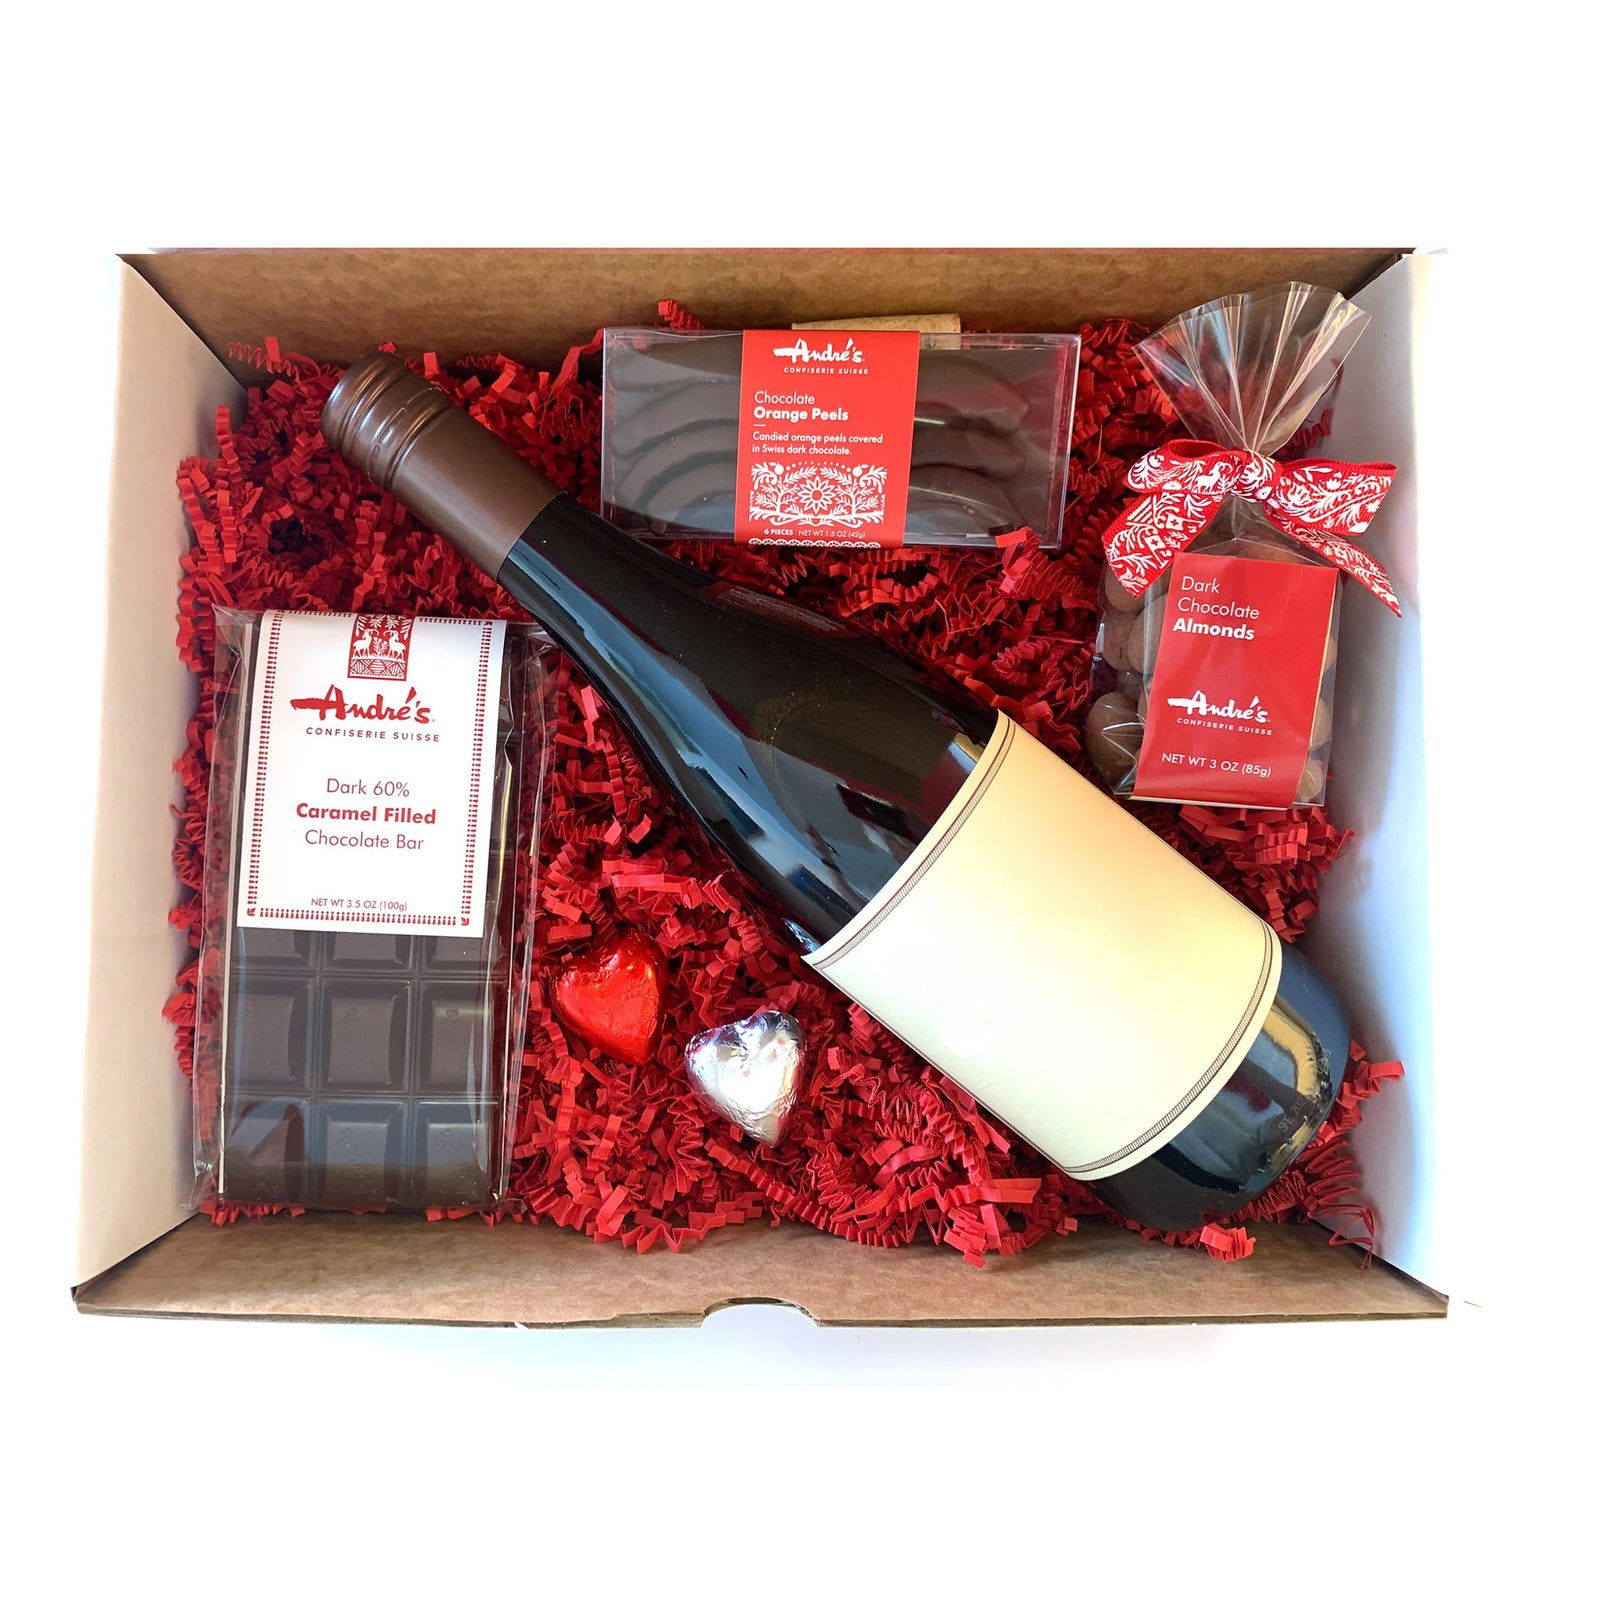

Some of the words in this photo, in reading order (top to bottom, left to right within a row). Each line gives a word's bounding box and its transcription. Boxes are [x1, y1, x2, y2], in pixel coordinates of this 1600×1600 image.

[773, 338, 864, 363] André's
[754, 391, 815, 404] Chocolate
[754, 406, 808, 423] Orange
[812, 408, 848, 420] Peels
[752, 431, 789, 442] Candied
[791, 434, 821, 444] orange
[824, 433, 846, 444] peels
[848, 434, 883, 443] covered
[752, 444, 760, 453] in
[762, 444, 784, 454] Swiss
[786, 444, 806, 454] dark
[808, 445, 852, 456] chocolate.
[848, 531, 866, 540] (42g)
[1181, 576, 1220, 594] Dark
[1178, 596, 1260, 620] Chocolate
[1172, 618, 1255, 640] Almonds
[290, 684, 432, 724] André's
[1167, 690, 1268, 724] André's
[306, 727, 386, 740] CONFISERIE
[393, 732, 440, 742] SUISSE
[1176, 718, 1234, 731] CONFISERIE
[1238, 726, 1272, 736] SUISSE
[1161, 752, 1184, 764] NET
[1188, 756, 1206, 768] WT
[1210, 758, 1216, 770] 3
[1220, 760, 1238, 772] OZ
[1242, 762, 1272, 778] (85g)
[326, 778, 366, 795] Dark
[373, 780, 410, 798] 60%
[296, 802, 376, 822] Caramel
[384, 808, 436, 824] Filled
[304, 829, 389, 849] Chocolate
[396, 834, 424, 850] Bar
[311, 898, 328, 906] NET
[330, 899, 344, 907] WT
[346, 900, 360, 908] 3.5
[364, 900, 376, 908] OZ
[380, 901, 407, 912] (100g)
